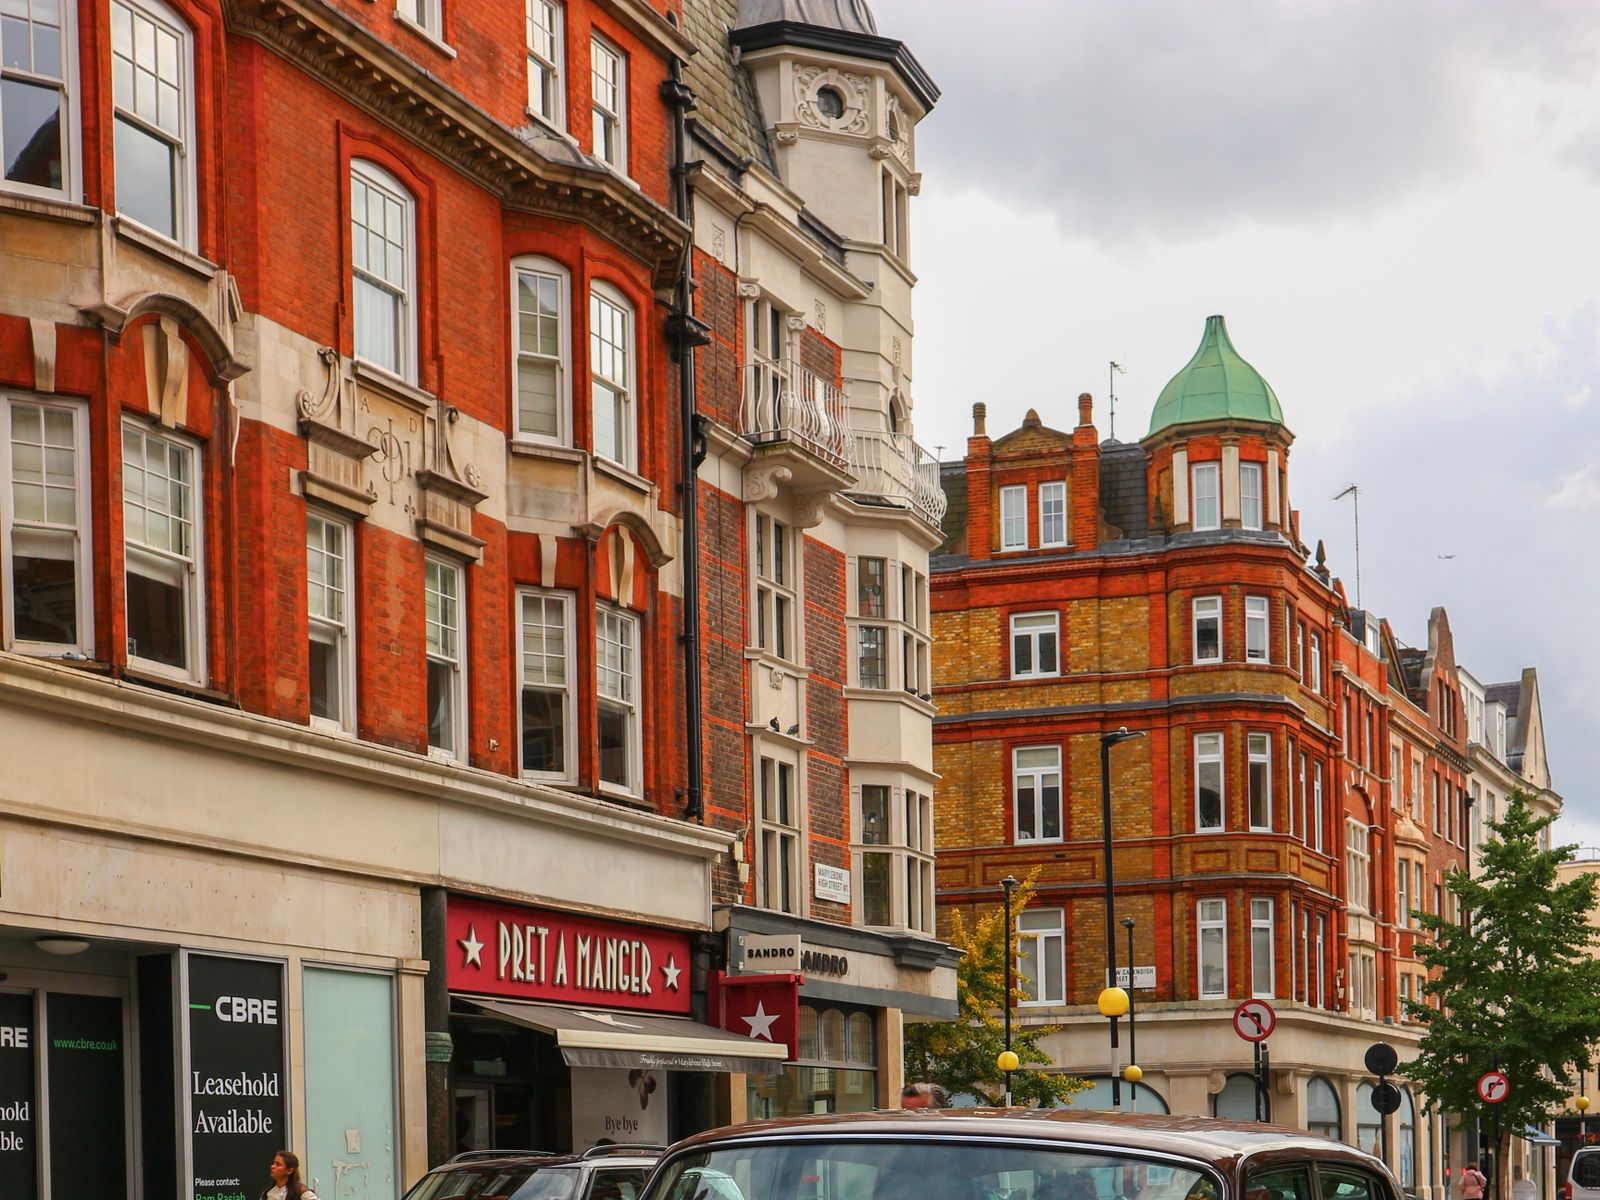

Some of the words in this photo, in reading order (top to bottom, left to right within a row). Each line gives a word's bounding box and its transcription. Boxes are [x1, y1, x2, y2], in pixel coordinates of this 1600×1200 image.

[818, 867, 844, 882] MARYLEBONE
[818, 878, 828, 889] HIGH
[829, 880, 842, 891] STREET
[498, 920, 549, 984] PRET
[553, 928, 568, 987] A
[575, 932, 652, 995] MANGER
[747, 947, 795, 959] SANDRO
[801, 950, 849, 976] ANDRO
[1122, 968, 1154, 976] CAENDISH
[215, 995, 278, 1025] CBRE
[53, 1036, 118, 1050] www.cbre.co.uk
[193, 1071, 279, 1097] Leasehold
[194, 1108, 273, 1134] Available
[605, 1115, 621, 1135] Bye
[623, 1115, 638, 1135] bye
[0, 1131, 24, 1151] ble
[195, 1177, 215, 1187] Please
[216, 1178, 240, 1187] contact:
